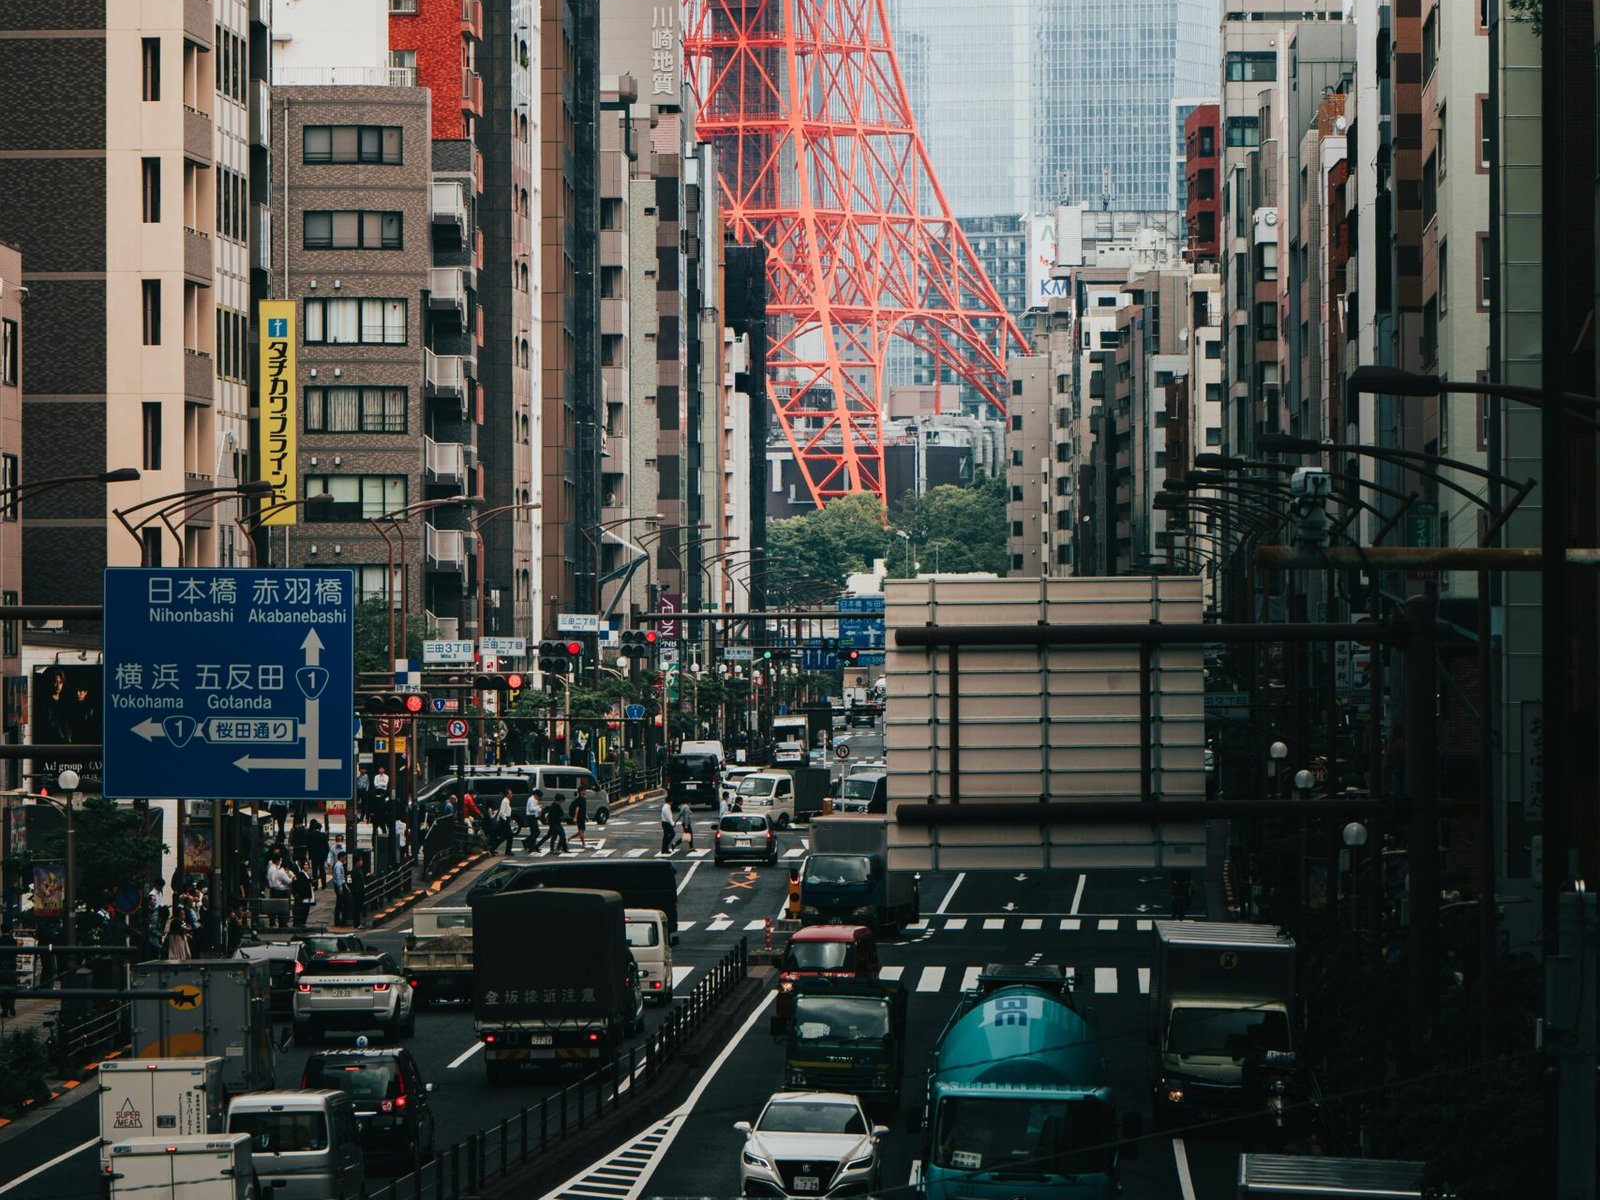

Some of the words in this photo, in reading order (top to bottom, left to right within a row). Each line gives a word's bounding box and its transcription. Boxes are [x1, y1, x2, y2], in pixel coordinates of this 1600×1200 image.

[651, 6, 674, 96] 川崎地質
[148, 576, 237, 605] 日本橋
[252, 577, 343, 606] 赤羽橋
[149, 608, 234, 623] Nihonbashi
[248, 609, 347, 624] Akabanebashi
[426, 643, 471, 653] 三田3丁目
[483, 640, 523, 649] 三田二丁目
[115, 663, 180, 690] 横浜
[195, 664, 284, 691] 五反田
[308, 671, 316, 689] 1
[112, 693, 184, 709] Yokohama
[207, 694, 272, 710] Gotanda
[437, 701, 441, 709] 1
[175, 721, 183, 737] 1
[215, 722, 289, 739] 桜田通り
[58, 763, 83, 773] group
[116, 1111, 140, 1119] SUPER
[118, 1119, 138, 1127] MEAT
